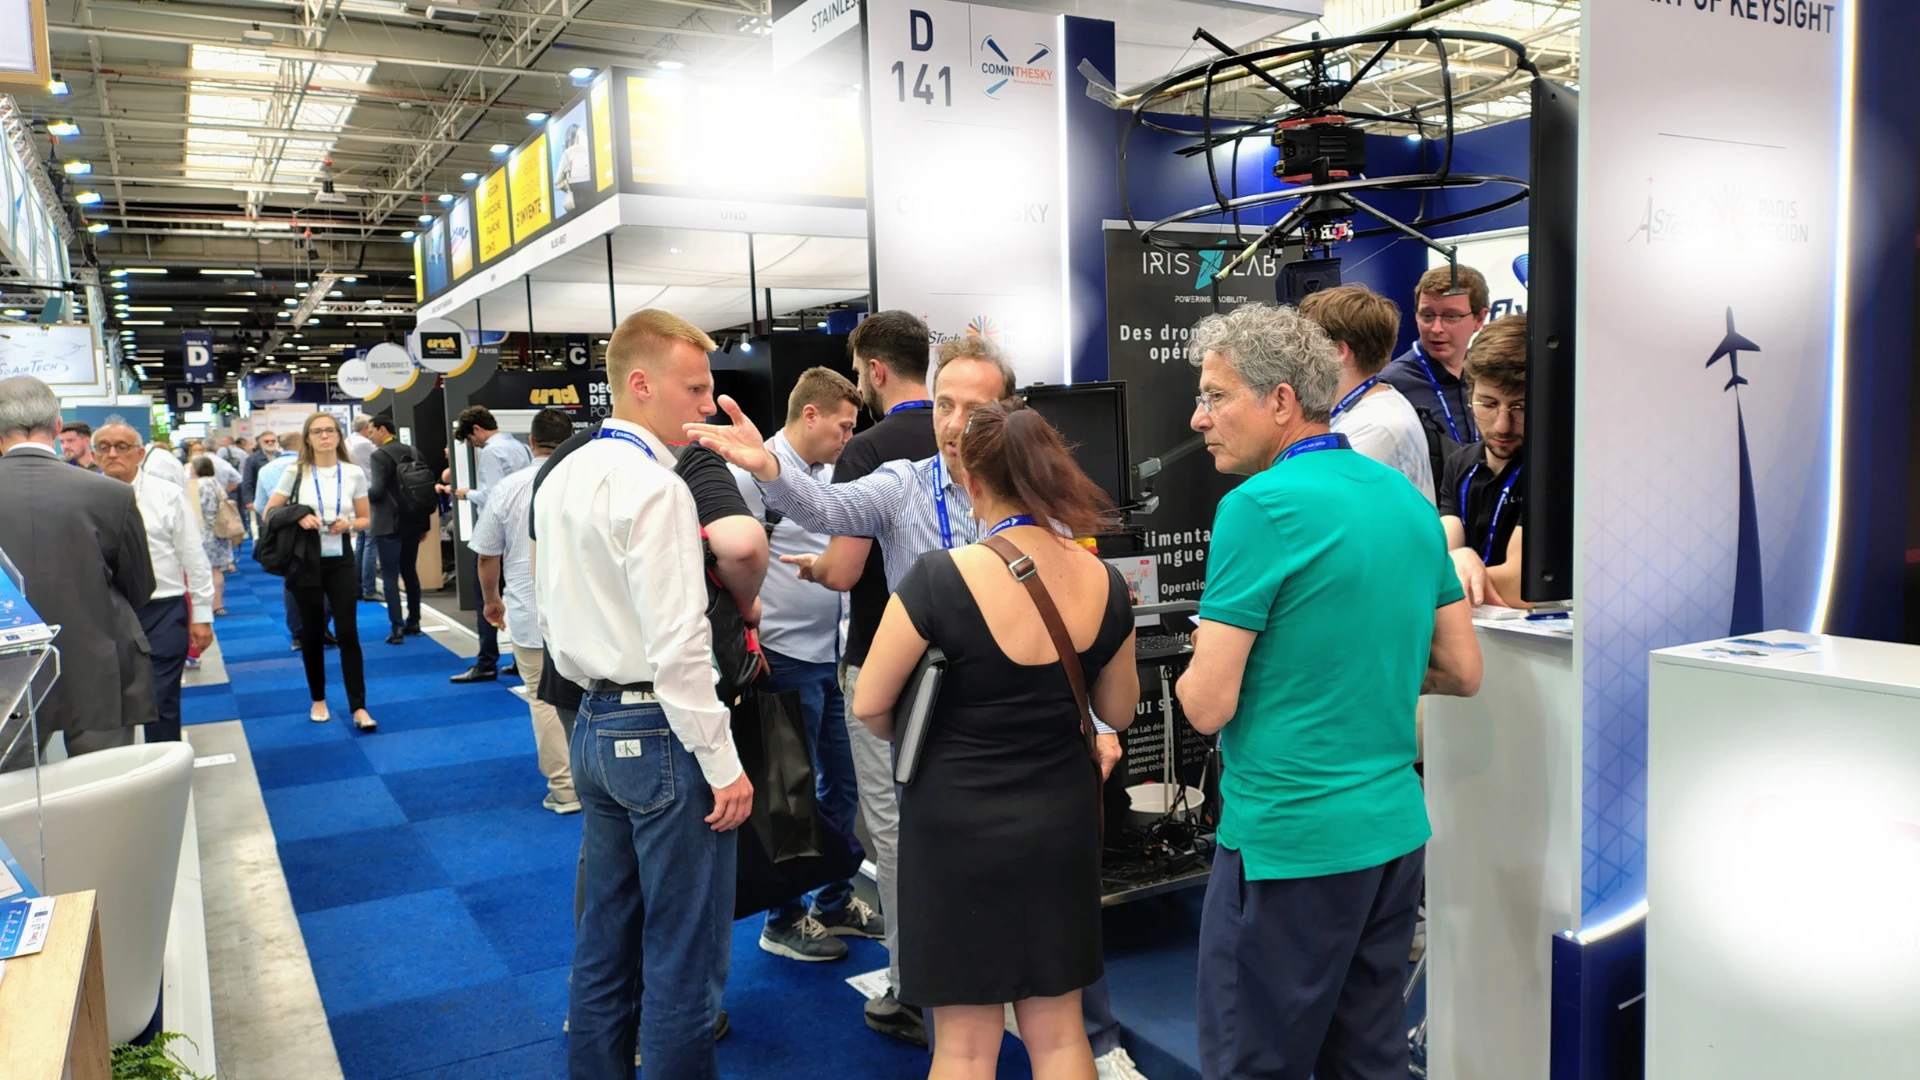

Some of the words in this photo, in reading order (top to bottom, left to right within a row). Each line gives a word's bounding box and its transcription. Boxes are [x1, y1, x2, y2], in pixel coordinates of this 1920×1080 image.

[1730, 0, 1835, 33] KEYSIGHT
[909, 9, 934, 52] D
[981, 62, 1053, 80] COMINTHESKY
[891, 60, 952, 107] 141
[720, 209, 747, 222] UND
[1758, 198, 1798, 220] PARIS
[1142, 251, 1191, 276] IRIS
[1232, 252, 1277, 277] LAB
[928, 330, 961, 345] STech
[1120, 325, 1152, 341] Des
[1160, 323, 1200, 341] dron
[187, 346, 210, 367] D
[569, 346, 587, 365] C
[1149, 341, 1189, 364] opér
[176, 391, 194, 408] D
[589, 395, 607, 406] DE
[615, 431, 648, 450] EMBRAER
[1144, 527, 1212, 548] limenta
[1157, 548, 1205, 568] ngue
[1160, 579, 1207, 597] Operatio
[1137, 701, 1152, 715] UI
[1127, 726, 1139, 736] Iris
[1140, 724, 1152, 733] Lab
[1152, 722, 1165, 731] dév
[1127, 733, 1165, 746] transmissio
[1127, 743, 1165, 756] développon
[1128, 754, 1160, 767] puissance
[1128, 766, 1148, 776] moins
